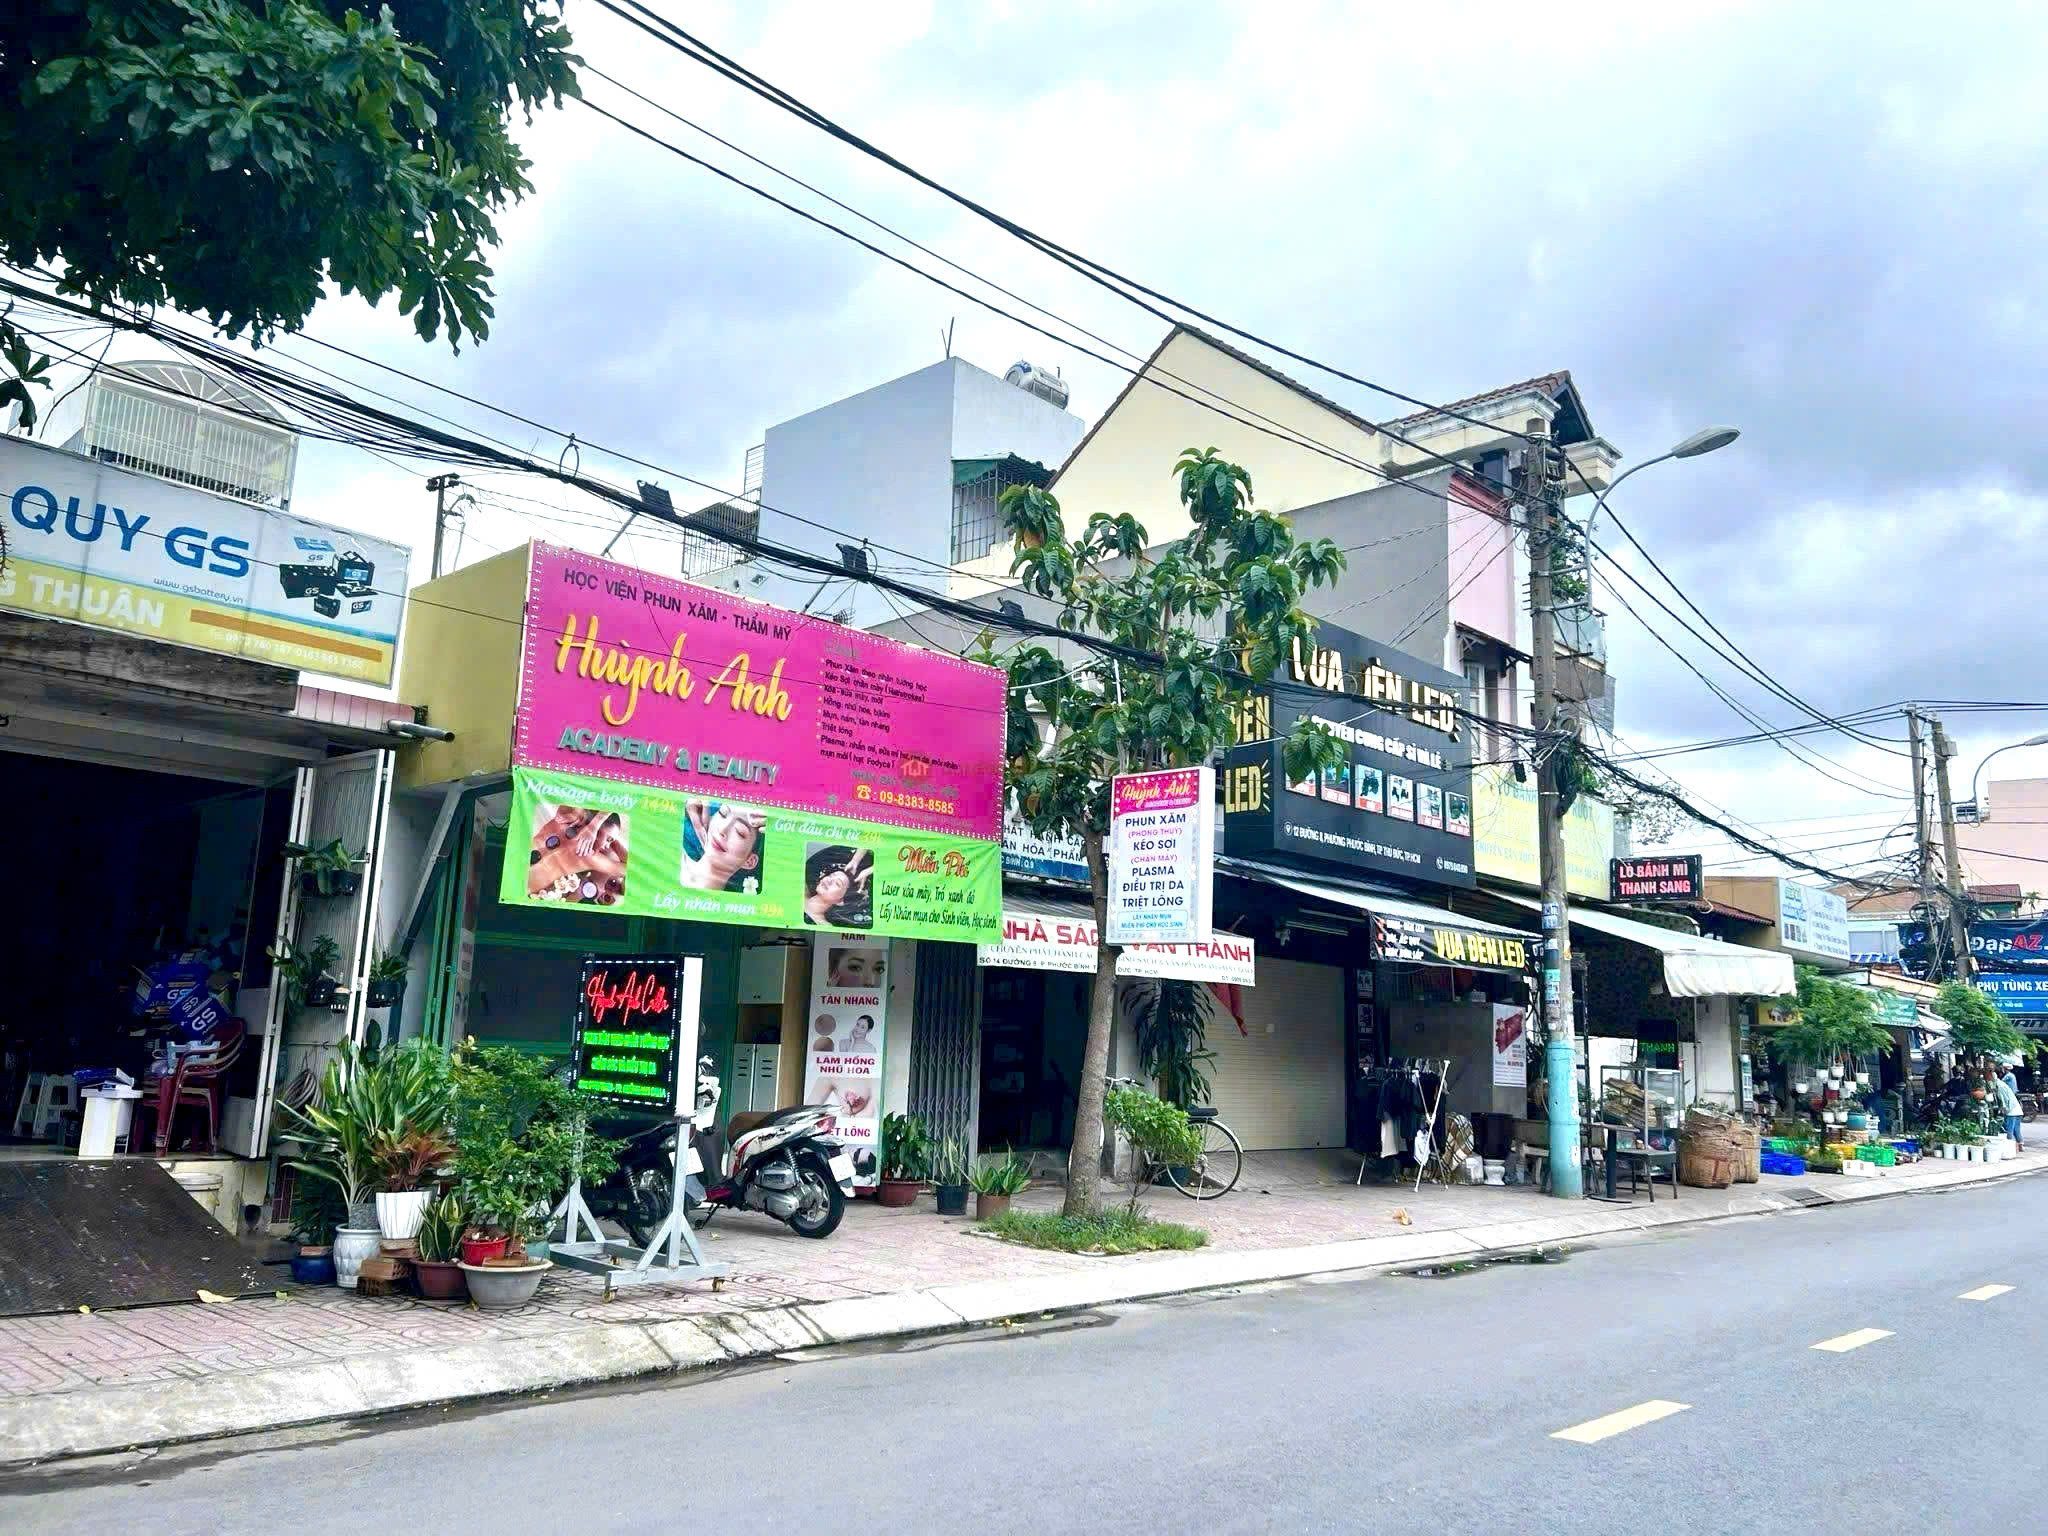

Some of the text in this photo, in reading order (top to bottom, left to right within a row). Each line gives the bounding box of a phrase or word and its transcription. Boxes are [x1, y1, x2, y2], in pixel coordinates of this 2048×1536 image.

[11, 485, 250, 578] QUY GS
[28, 573, 165, 629] THUẬN
[564, 568, 599, 591] HỌC
[605, 579, 637, 601] VIỆN
[644, 591, 681, 613] PHUN
[733, 612, 768, 636] THẨM
[774, 625, 792, 641] MỸ
[554, 613, 792, 726] Huỳnh Anh
[1411, 681, 1455, 732] LED
[557, 727, 779, 785] ACADEMY & BEAUTY
[527, 779, 635, 808] Massage body
[1225, 765, 1262, 813] LED
[880, 790, 954, 815] 09-8383-8585
[1125, 811, 1186, 827] PHUN XĂM
[1133, 839, 1177, 852] KÉO SỢI
[1132, 865, 1176, 877] PLASMA
[1619, 863, 1634, 879] LÒ
[1636, 861, 1669, 878] BÁNH
[1672, 860, 1688, 876] MÌ
[881, 880, 900, 897] Laser
[1122, 878, 1185, 893] ĐIỀU TRỊ DA
[1620, 880, 1691, 895] THANH SANG
[654, 890, 680, 912] Lấy
[1122, 894, 1184, 910] TRIỆT LÔNG
[1002, 918, 1099, 947] NHÀ SÁC
[1433, 929, 1466, 961] VUA
[1498, 939, 1526, 969] LED
[1002, 957, 1031, 967] ĐƯỜNG
[1976, 981, 1999, 993] PHỤ
[2002, 979, 2033, 992] TÙNG
[844, 995, 880, 1006] NHANG
[192, 1007, 217, 1031] GS
[848, 1065, 871, 1075] HOA
